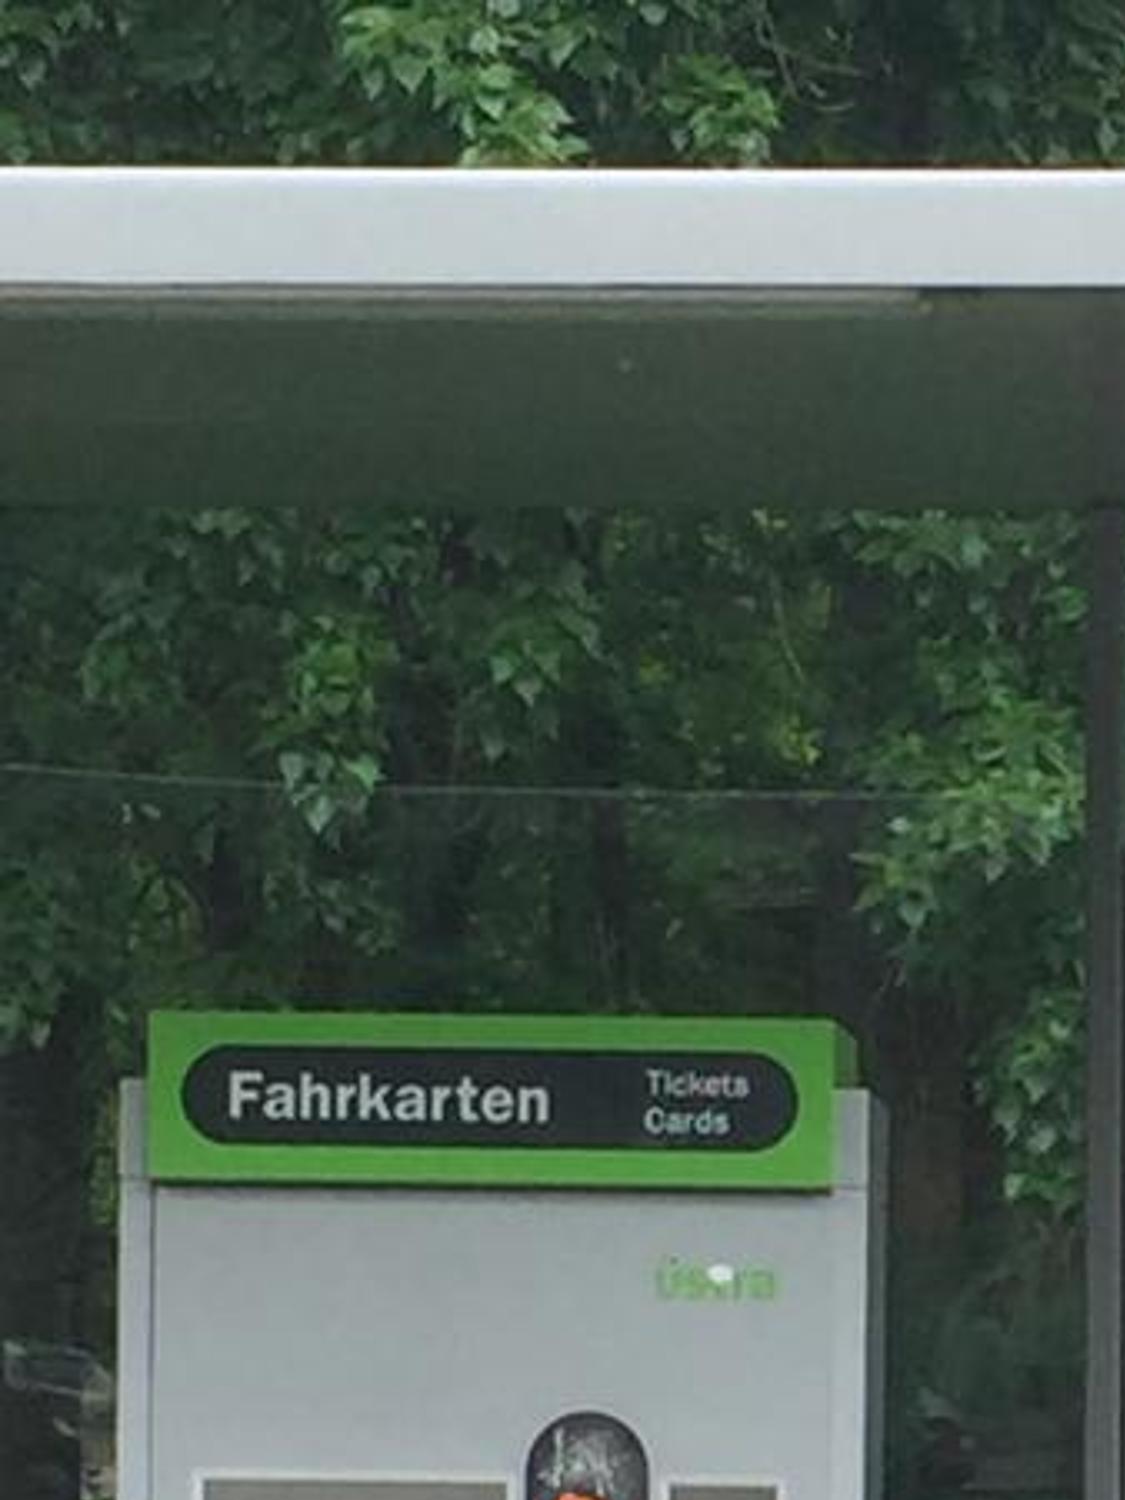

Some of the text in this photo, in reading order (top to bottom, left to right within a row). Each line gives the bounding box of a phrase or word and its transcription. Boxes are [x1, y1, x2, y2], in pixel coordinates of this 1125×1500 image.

[227, 1070, 551, 1125] Fahrkarten
[645, 1068, 750, 1099] Tickets
[643, 1106, 731, 1135] Cards
